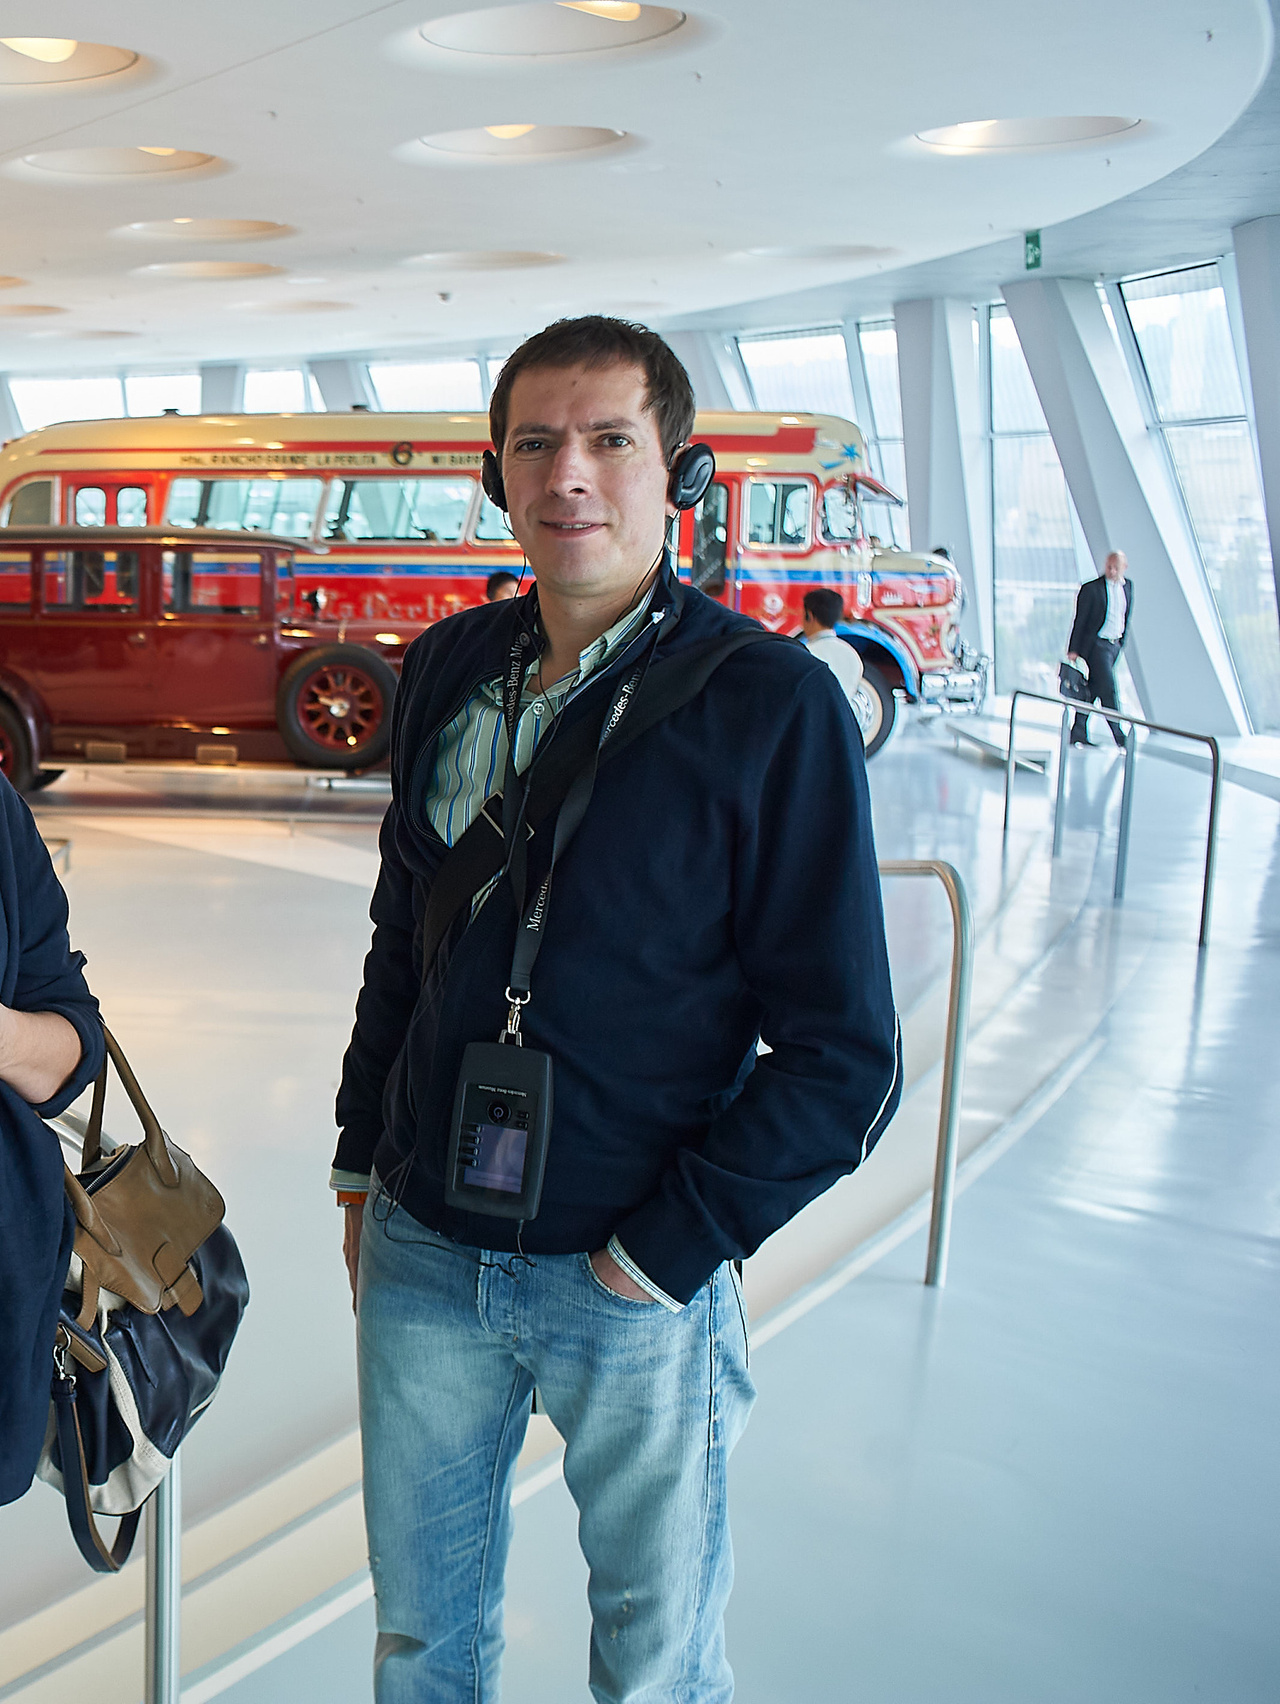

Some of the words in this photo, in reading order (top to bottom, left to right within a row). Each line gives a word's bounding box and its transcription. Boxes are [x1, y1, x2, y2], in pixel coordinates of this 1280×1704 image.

[391, 440, 414, 466] 6
[505, 660, 522, 736] rcedes-Benz
[603, 667, 643, 740] ercedes-Benz
